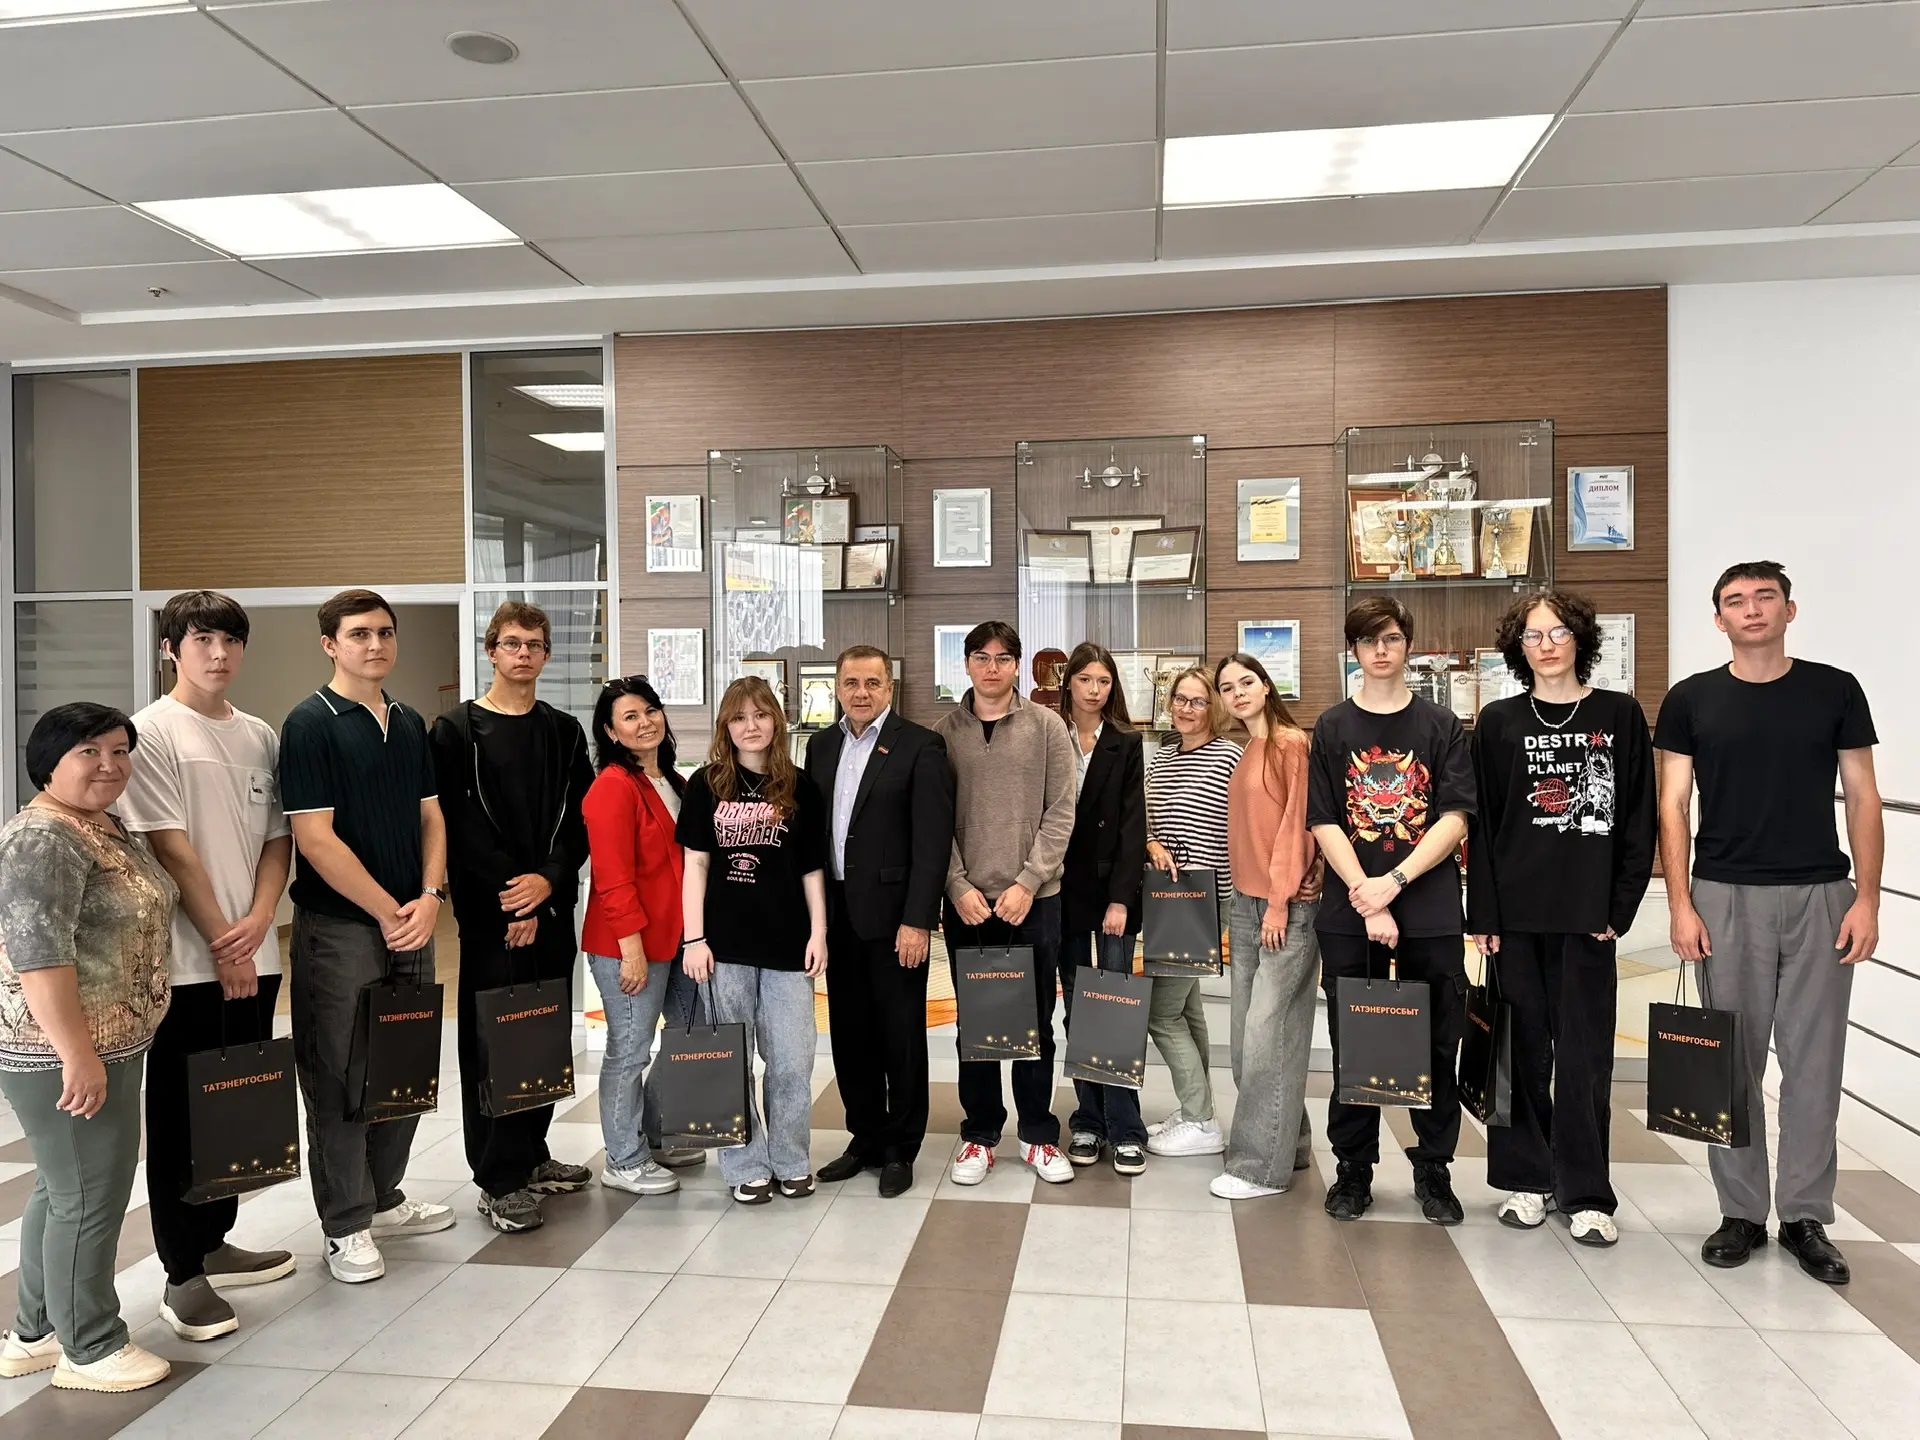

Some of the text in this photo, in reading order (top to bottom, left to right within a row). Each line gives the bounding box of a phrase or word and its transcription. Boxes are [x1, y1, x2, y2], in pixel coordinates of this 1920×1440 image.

[1588, 485, 1620, 493] ДИПЛОМ
[1524, 732, 1614, 749] DESTRY
[1526, 750, 1555, 762] THE
[1528, 763, 1582, 774] PLANET
[713, 800, 780, 819] ORIGINA
[727, 852, 761, 864] UNIVERSAL
[1152, 891, 1207, 900] ТАТЭНЕРГОСБЫТ
[966, 971, 1025, 981] ТАТЭНЕРГОСБЫТ
[1083, 991, 1141, 1006] ТАТЭНЕРГОСБЫТ
[379, 1010, 434, 1022] ТАТЭНЕРГОСБЫТ
[496, 1005, 559, 1023] ТАТЭНЕРГОСБЫТ
[1349, 1004, 1419, 1017] ТАТЭНЕРГОСБЫТ
[1658, 1031, 1721, 1048] ТАТЭНЕРГОСБЫТ
[671, 1050, 733, 1062] ТАТЭНЕРГОСБЫТ
[203, 1071, 283, 1092] ТАТЭНЕРГОСБЫТ
